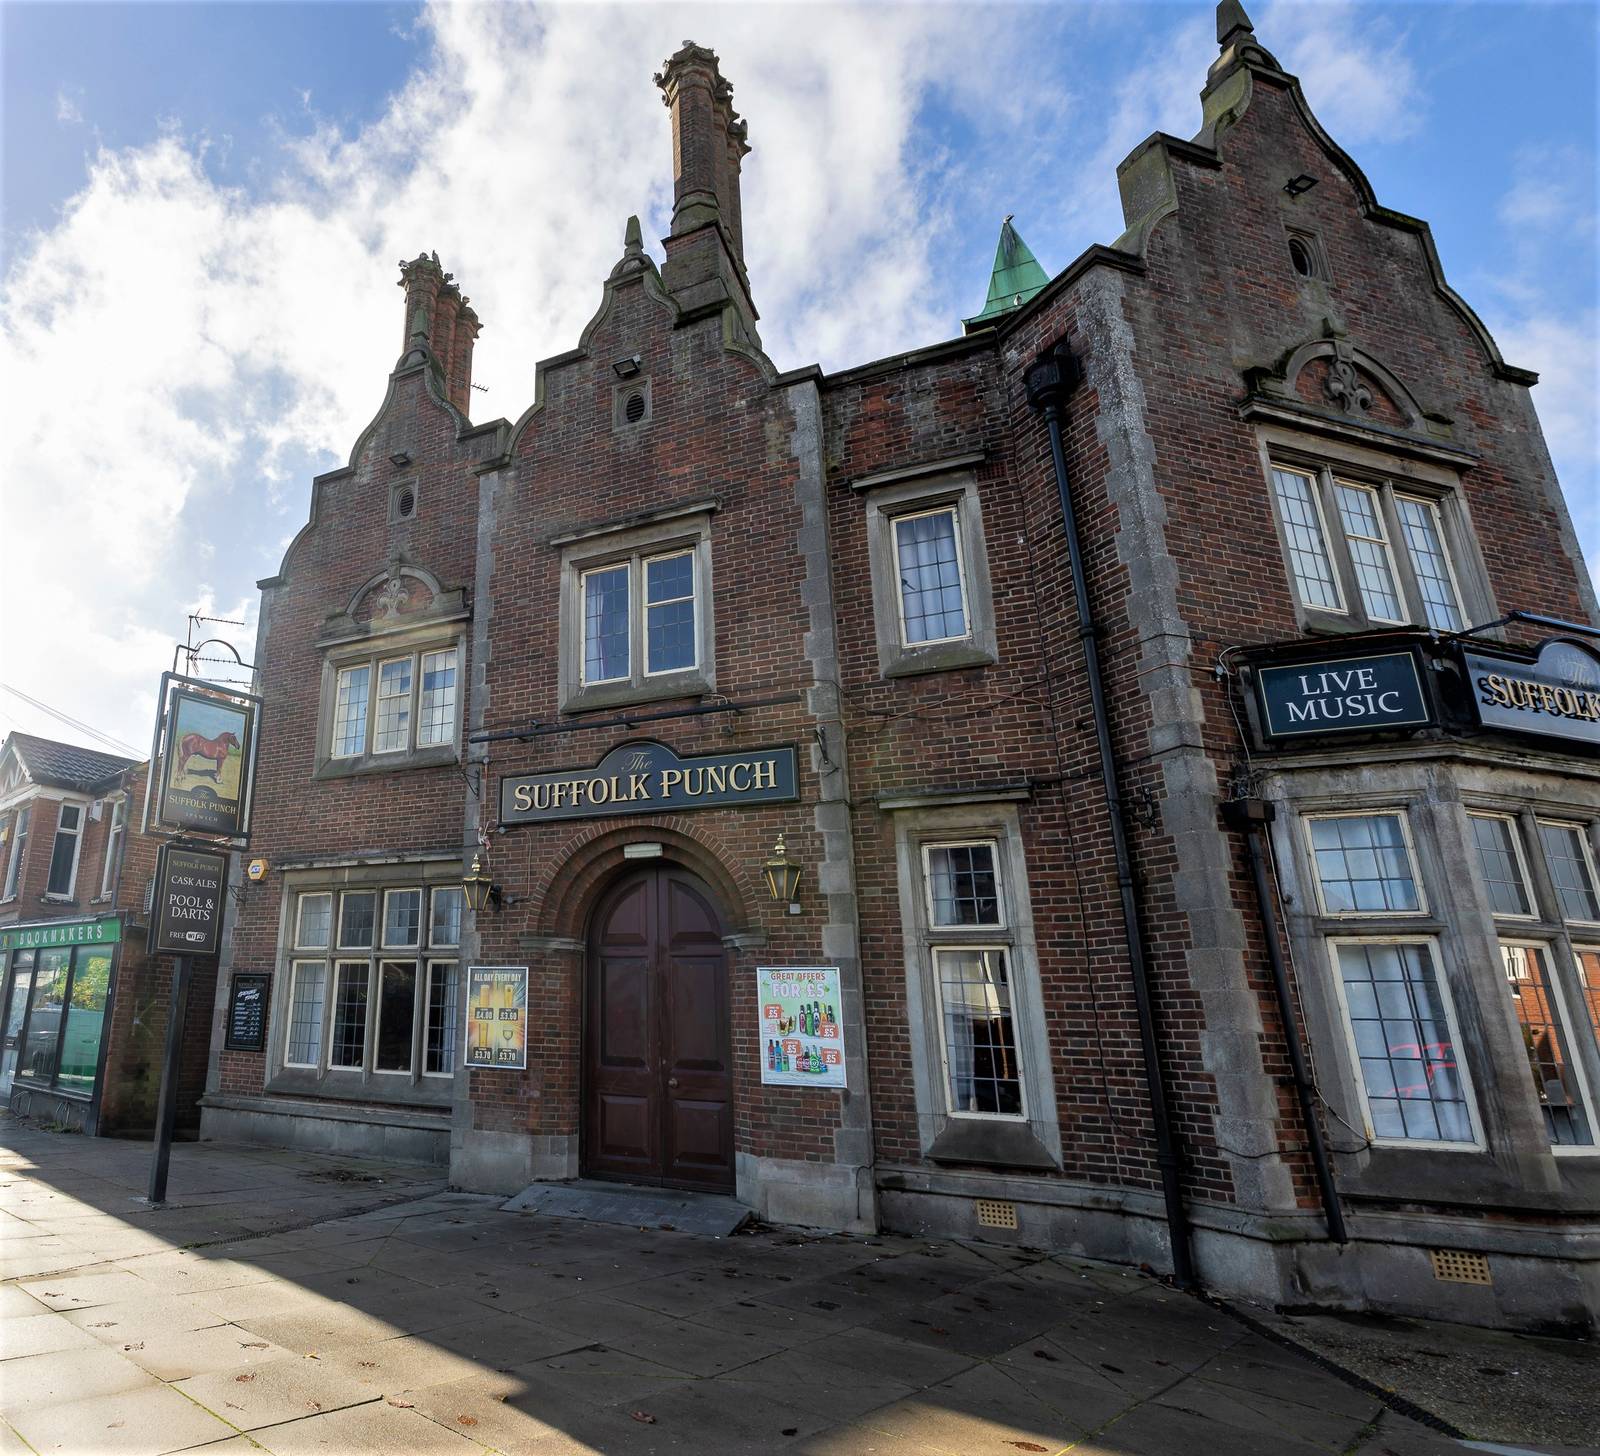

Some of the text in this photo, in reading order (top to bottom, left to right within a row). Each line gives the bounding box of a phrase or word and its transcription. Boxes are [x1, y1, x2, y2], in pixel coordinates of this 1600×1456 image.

[1299, 668, 1377, 696] LIVE
[1486, 673, 1600, 719] SUFFOLK
[1285, 691, 1403, 722] MUSIC
[621, 752, 653, 772] The
[512, 760, 777, 811] SUFFOLK PUNCH
[169, 794, 236, 815] SUFFOLK PUNCH
[185, 811, 219, 822] IPSWICH
[171, 875, 217, 889] CASK ALES
[169, 893, 214, 910] POOL &
[171, 906, 210, 921] DARTS
[20, 925, 103, 945] BOOKMAKERS
[169, 931, 185, 939] FREE
[474, 973, 521, 982] ALL DAY EVERY DAY
[770, 972, 826, 981] GREAT OFFERS
[772, 982, 825, 998] FOR £5
[768, 1009, 778, 1018] £5
[823, 1027, 835, 1037] £5
[786, 1044, 797, 1054] £5
[498, 1052, 516, 1061] £3.70
[825, 1054, 837, 1064] £5
